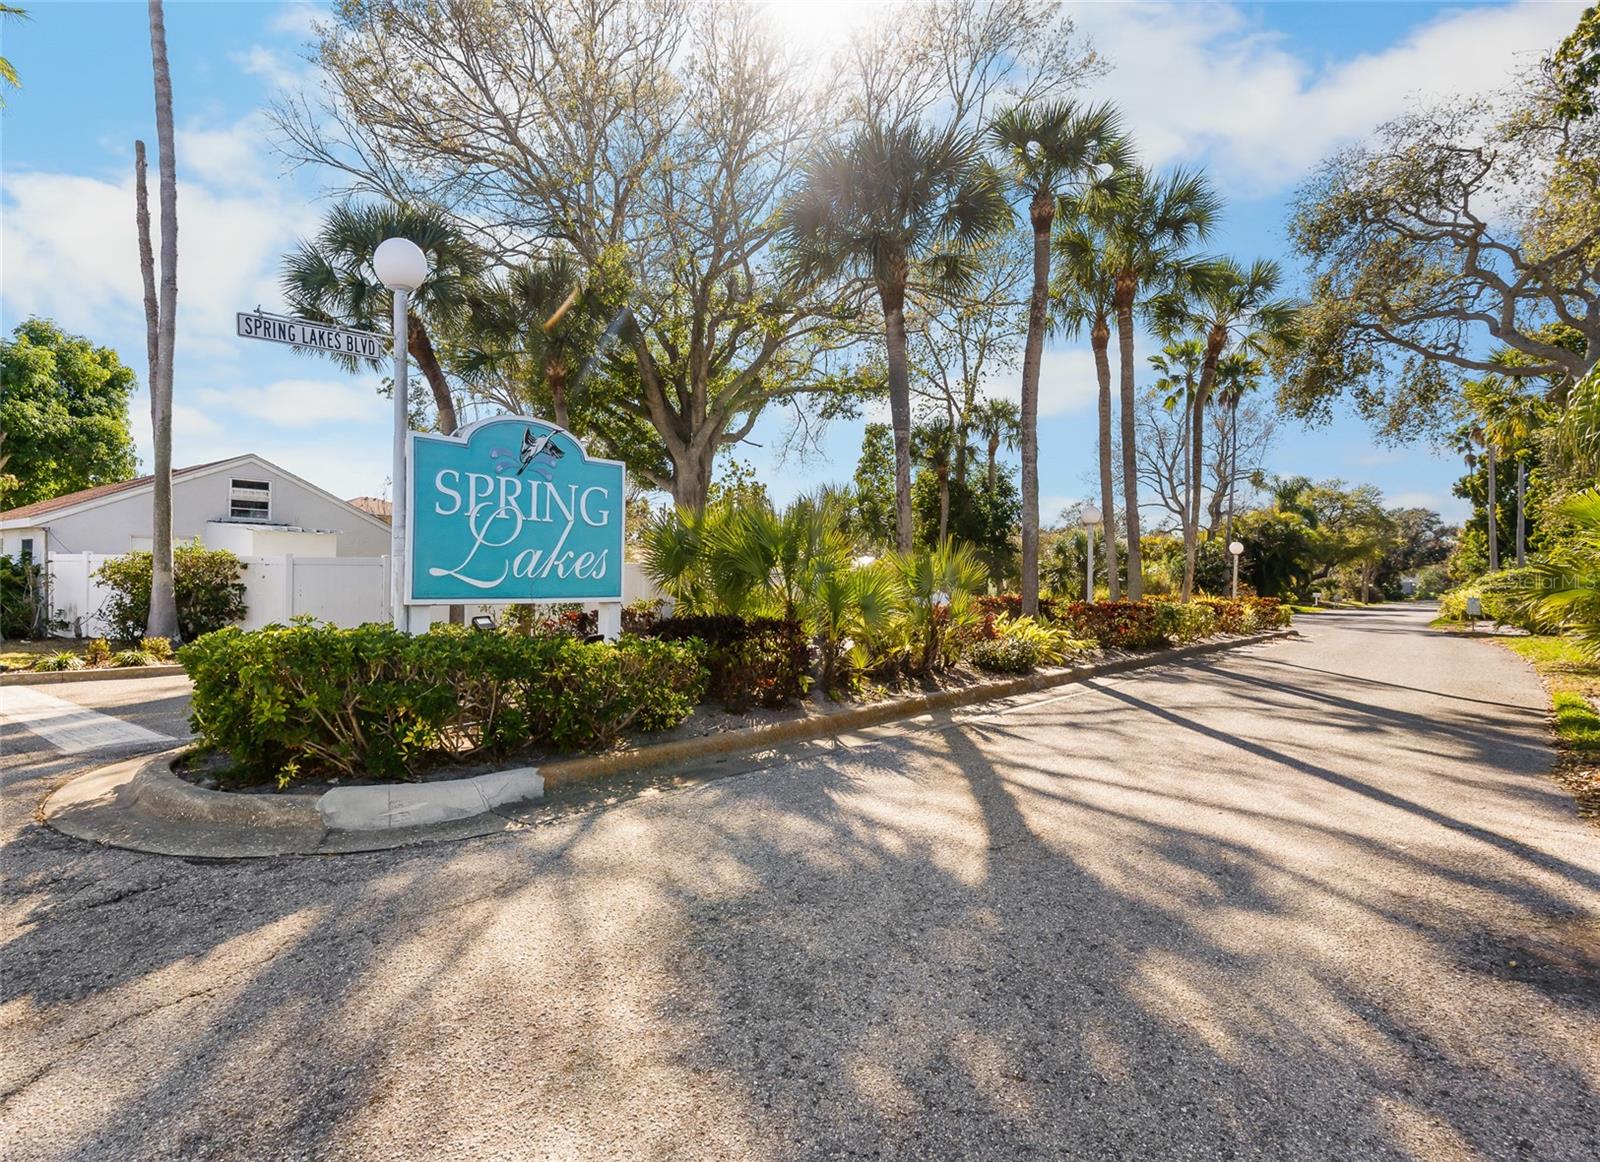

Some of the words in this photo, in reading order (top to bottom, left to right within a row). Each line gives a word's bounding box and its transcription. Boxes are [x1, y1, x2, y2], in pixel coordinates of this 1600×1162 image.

[244, 317, 296, 342] SPRING
[302, 327, 342, 350] LAKES
[346, 336, 376, 356] BLVD
[434, 469, 610, 526] SPRING
[429, 502, 609, 589] Lakes
